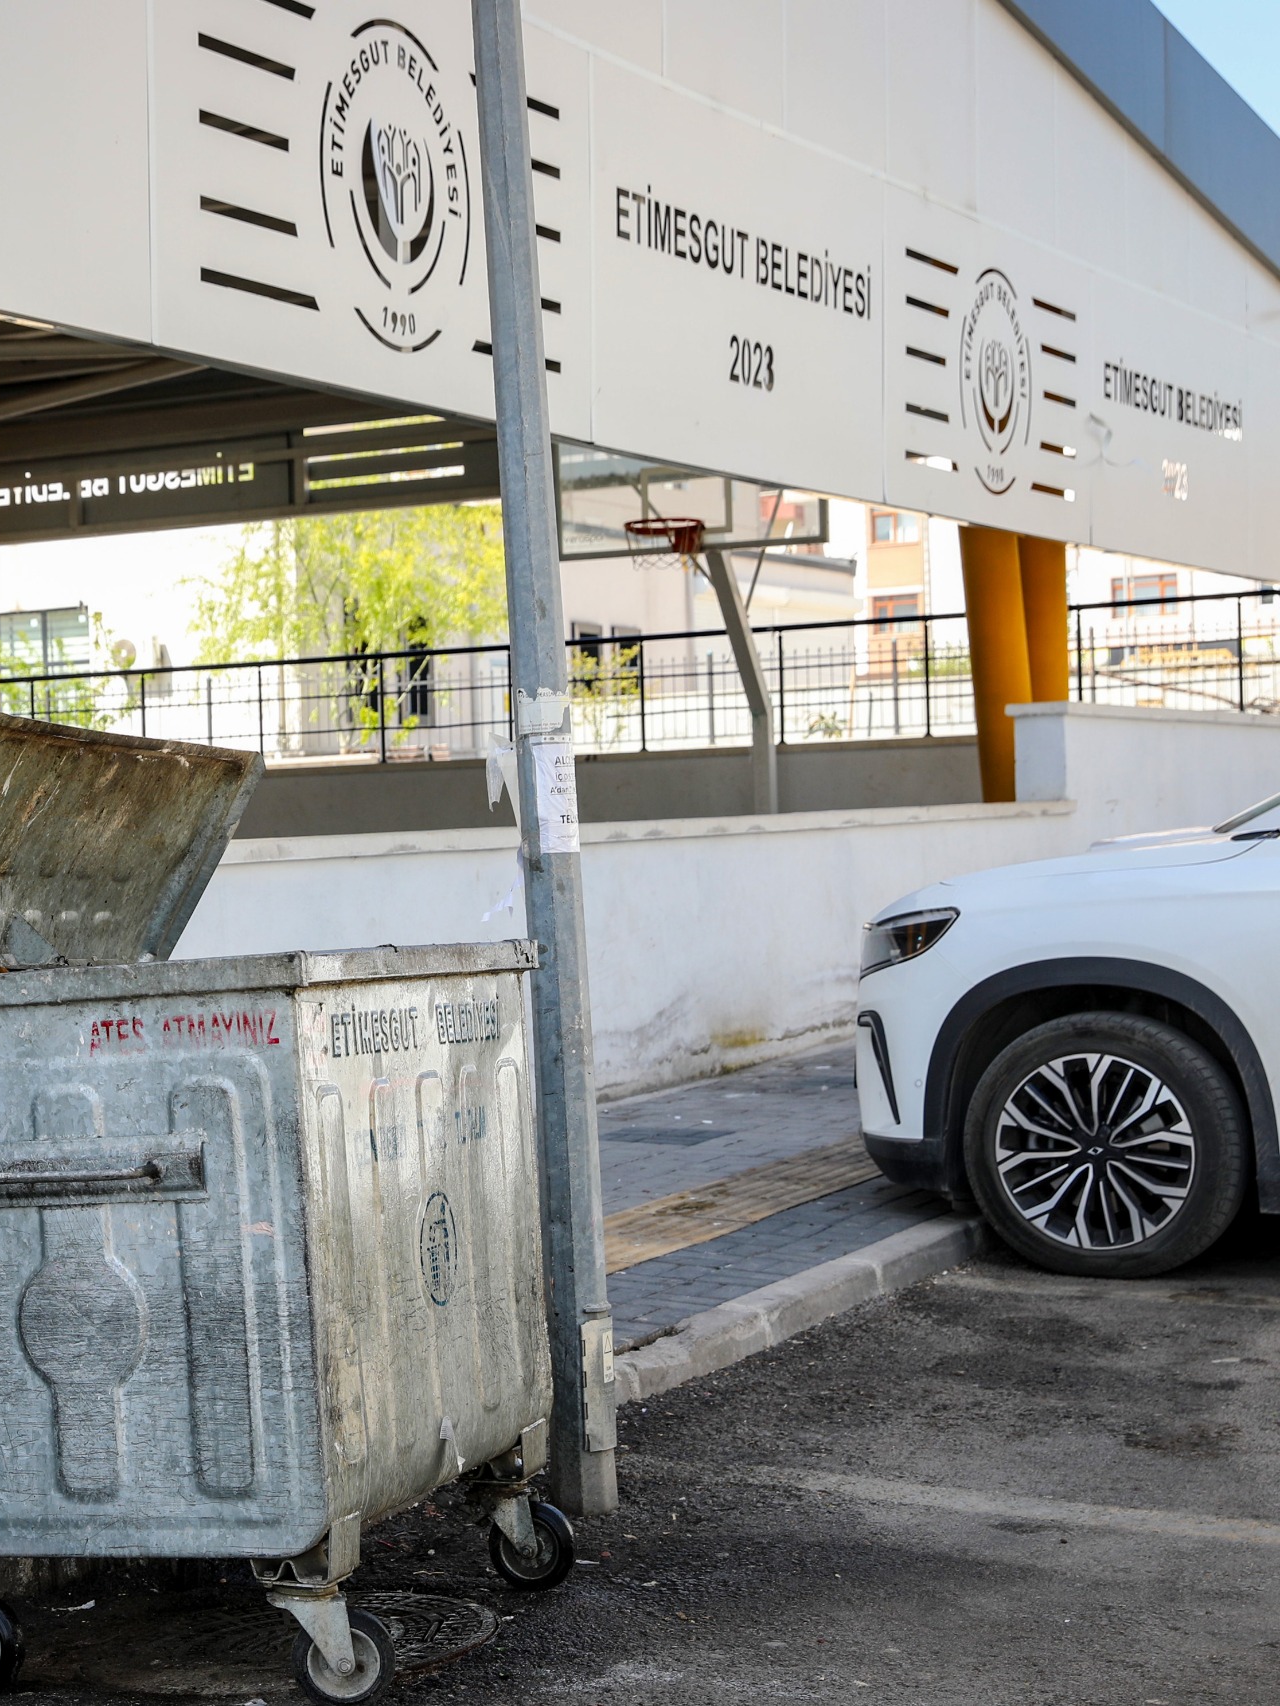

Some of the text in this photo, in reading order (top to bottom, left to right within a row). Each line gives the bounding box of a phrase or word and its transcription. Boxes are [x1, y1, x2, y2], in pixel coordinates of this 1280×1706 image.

[331, 40, 462, 219] ETİMESGUT BELEDİYESİ
[616, 184, 871, 320] ETİMESGUT BELEDİYESİ
[381, 305, 417, 336] 1990
[729, 334, 775, 392] 2023
[1104, 357, 1173, 420] ETİMESGUT
[162, 1008, 280, 1048] ATMAYINIZ
[330, 994, 500, 1059] ETİMESGUT BELEDİYESİ
